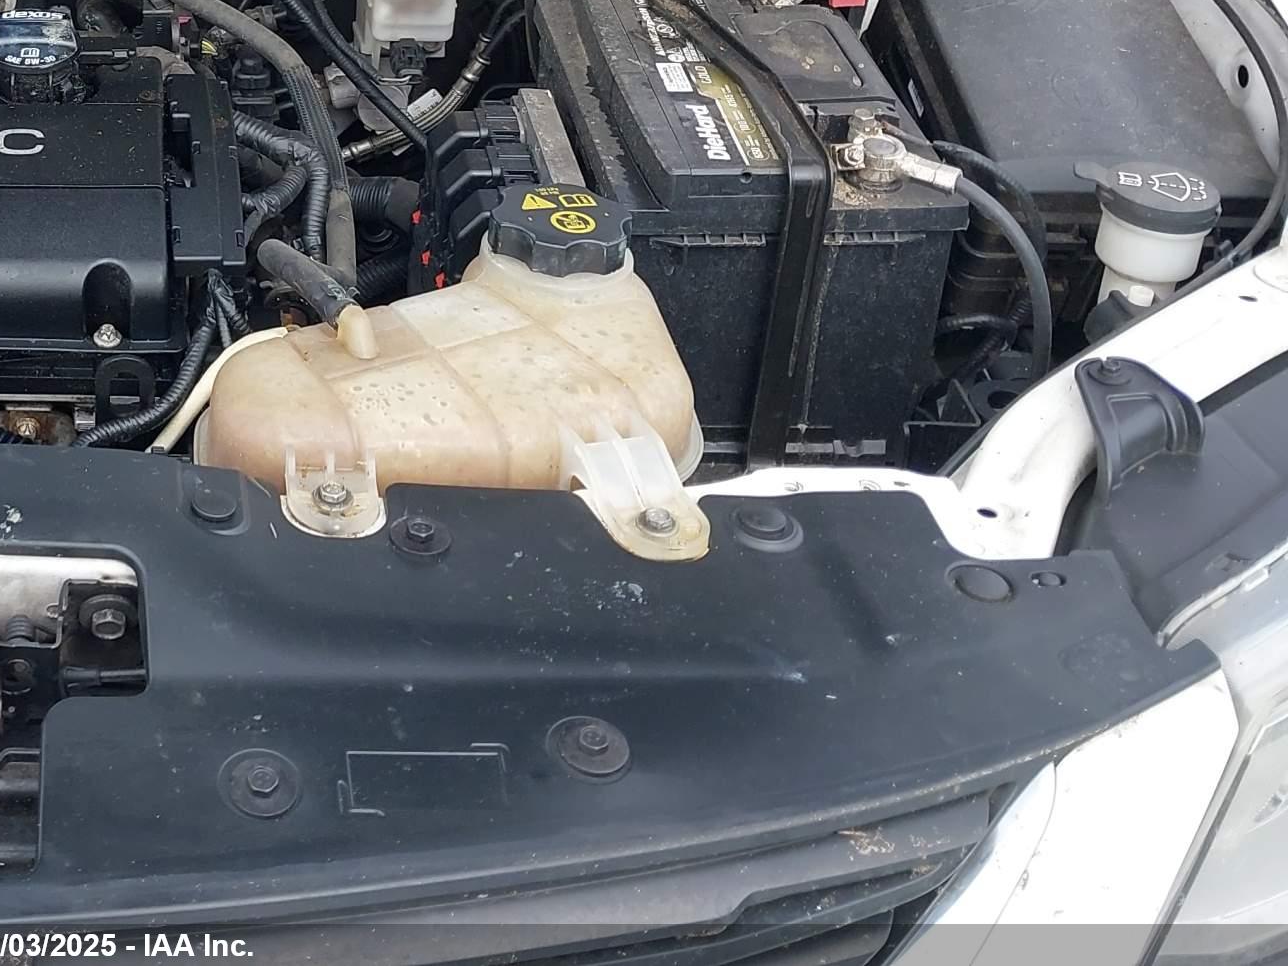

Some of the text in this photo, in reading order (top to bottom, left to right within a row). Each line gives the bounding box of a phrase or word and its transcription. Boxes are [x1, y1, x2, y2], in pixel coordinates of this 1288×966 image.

[1, 10, 64, 20] dexos
[4, 55, 21, 65] SAE
[695, 65, 712, 84] GOLD
[685, 103, 732, 161] DieHard
